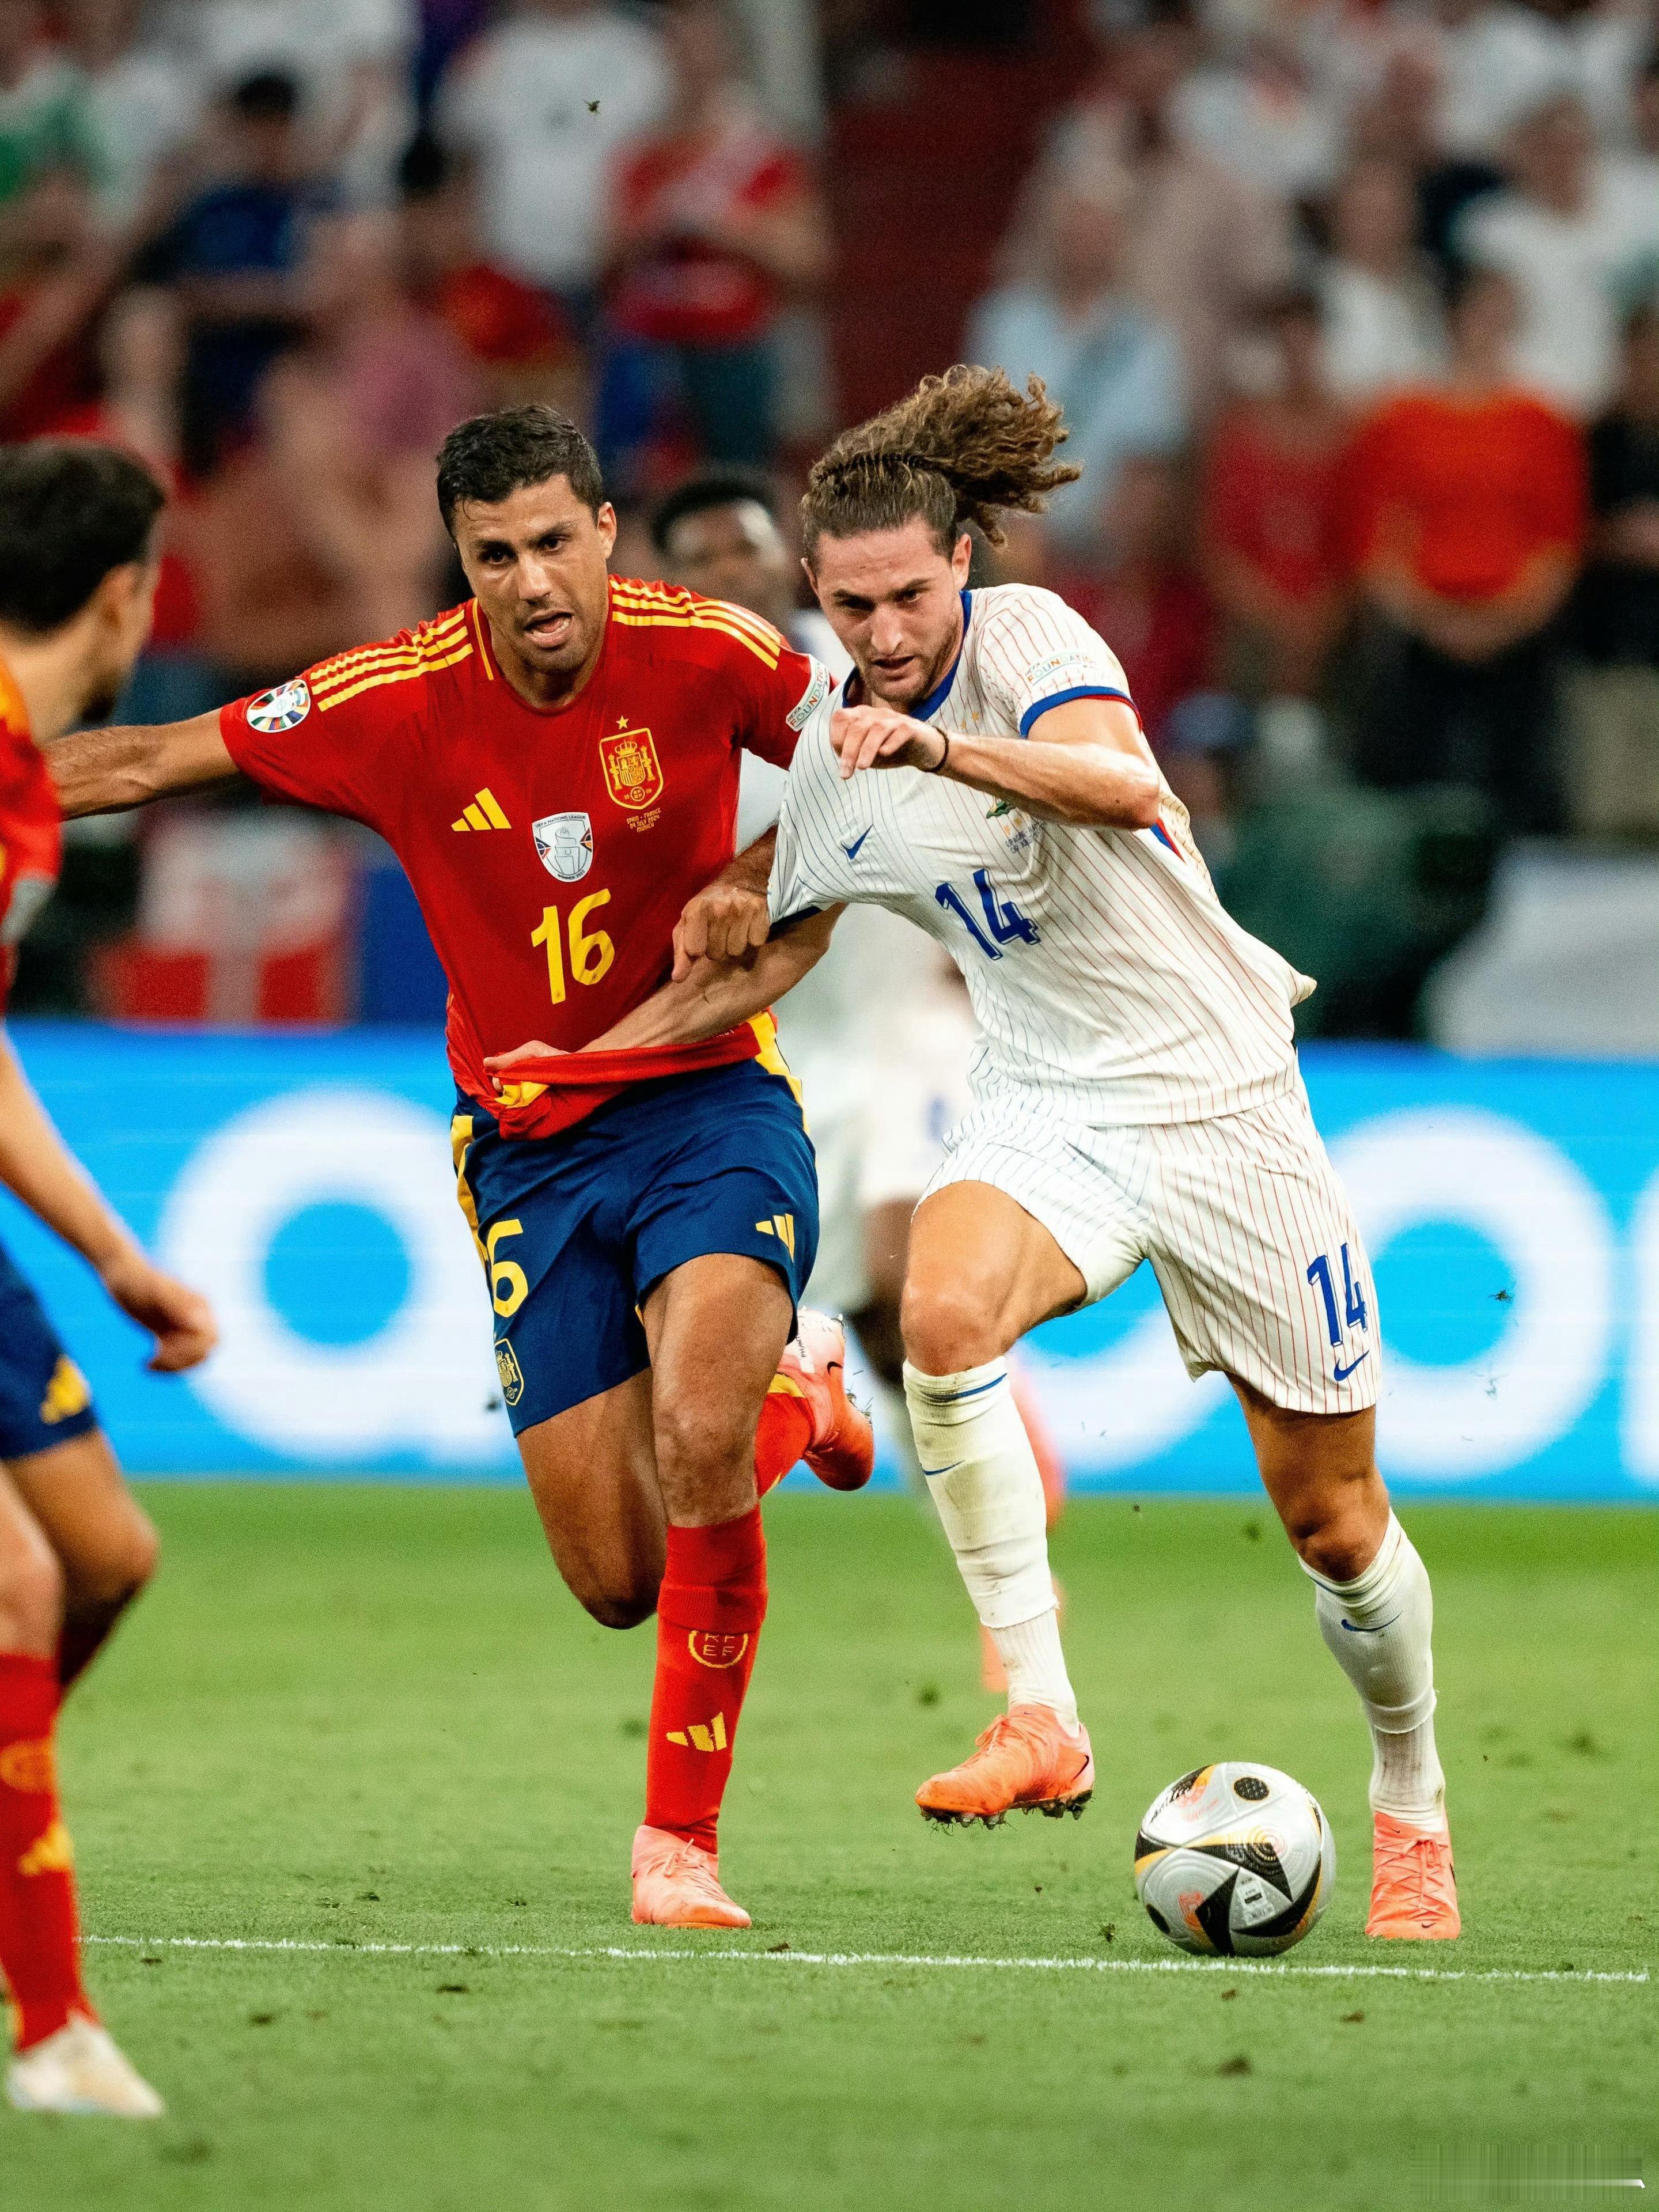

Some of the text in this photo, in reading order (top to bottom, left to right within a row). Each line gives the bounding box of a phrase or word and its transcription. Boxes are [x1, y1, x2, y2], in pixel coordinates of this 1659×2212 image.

[547, 815, 568, 823] NATIONS
[531, 888, 615, 1005] 16
[934, 868, 1040, 961] 14
[1306, 1242, 1368, 1347] 14
